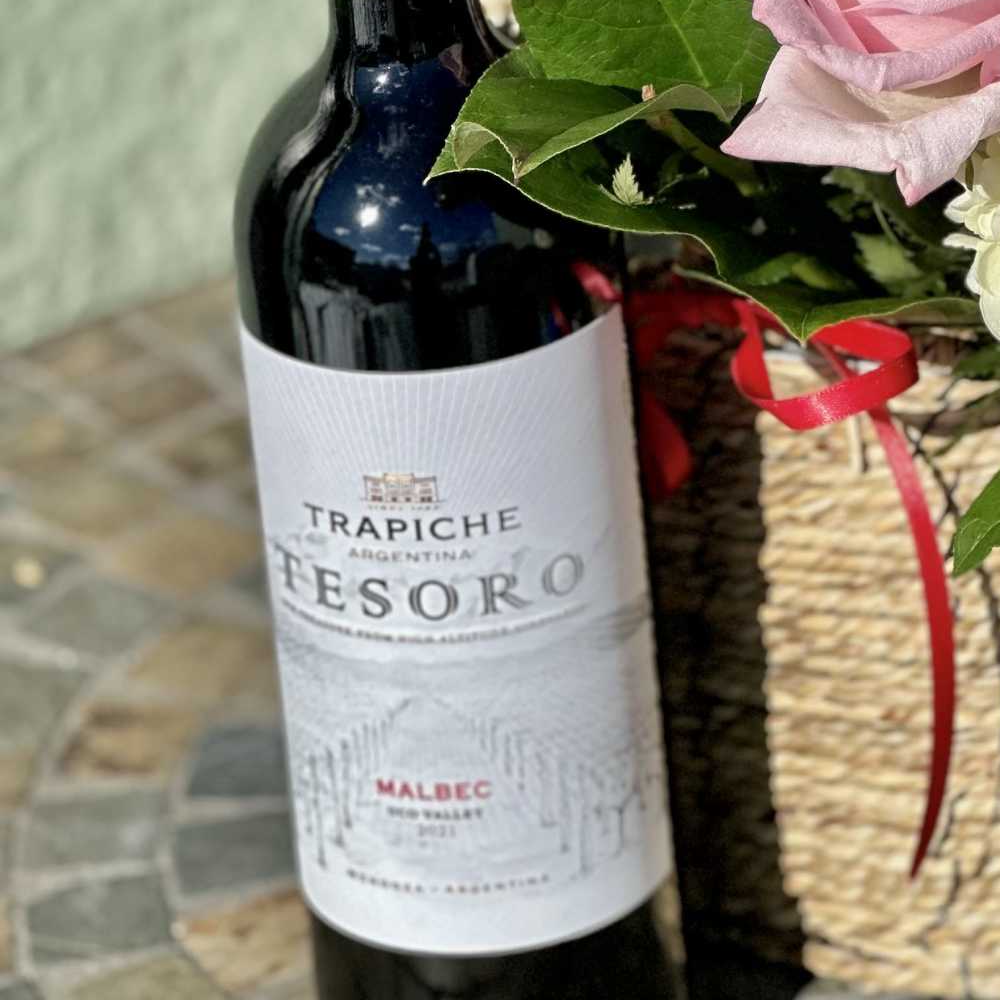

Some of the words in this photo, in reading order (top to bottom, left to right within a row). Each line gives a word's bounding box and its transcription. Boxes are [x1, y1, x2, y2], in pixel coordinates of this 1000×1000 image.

[303, 502, 522, 542] TRAPICHE
[348, 547, 474, 563] ARGENTINA
[273, 543, 585, 621] TESORO
[375, 778, 493, 801] MALBEC
